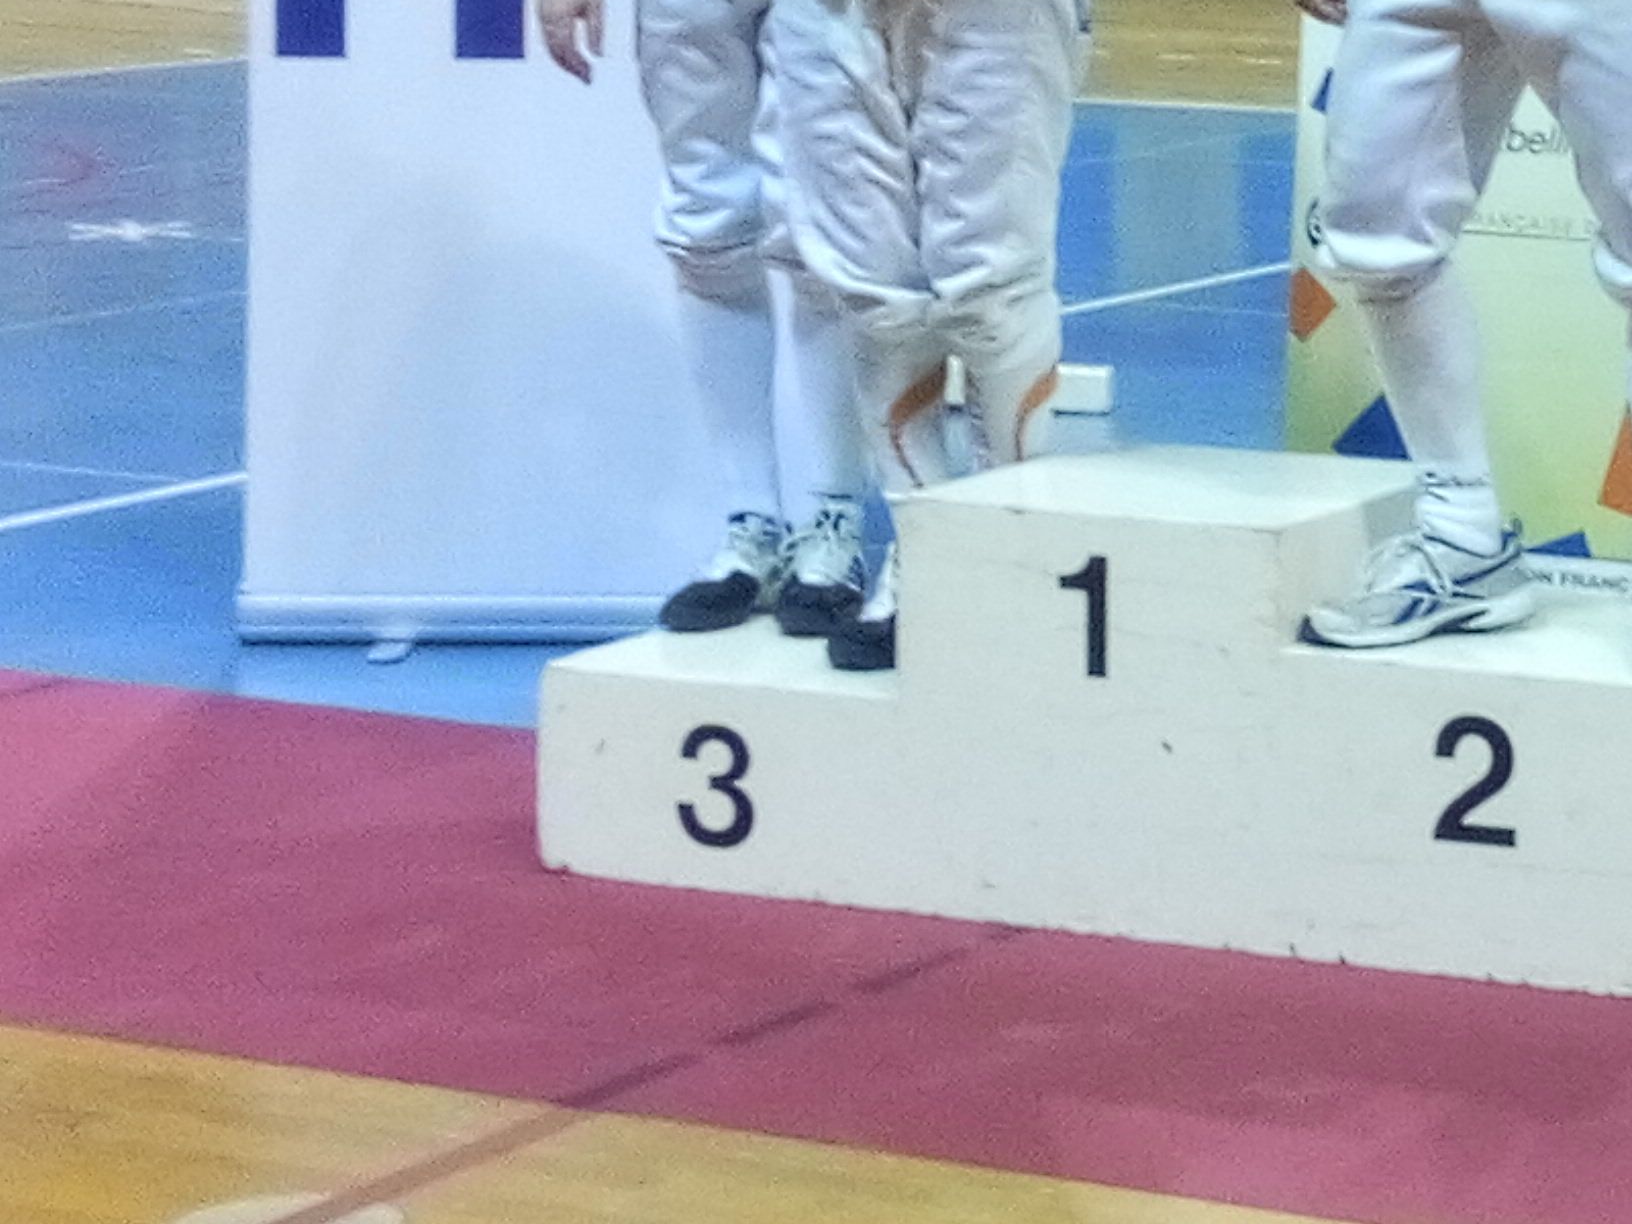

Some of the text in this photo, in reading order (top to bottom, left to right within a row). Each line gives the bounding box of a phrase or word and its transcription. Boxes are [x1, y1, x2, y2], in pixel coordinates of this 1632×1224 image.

[1059, 556, 1107, 678] 1
[677, 725, 754, 848] 3
[1434, 716, 1516, 847] 2
